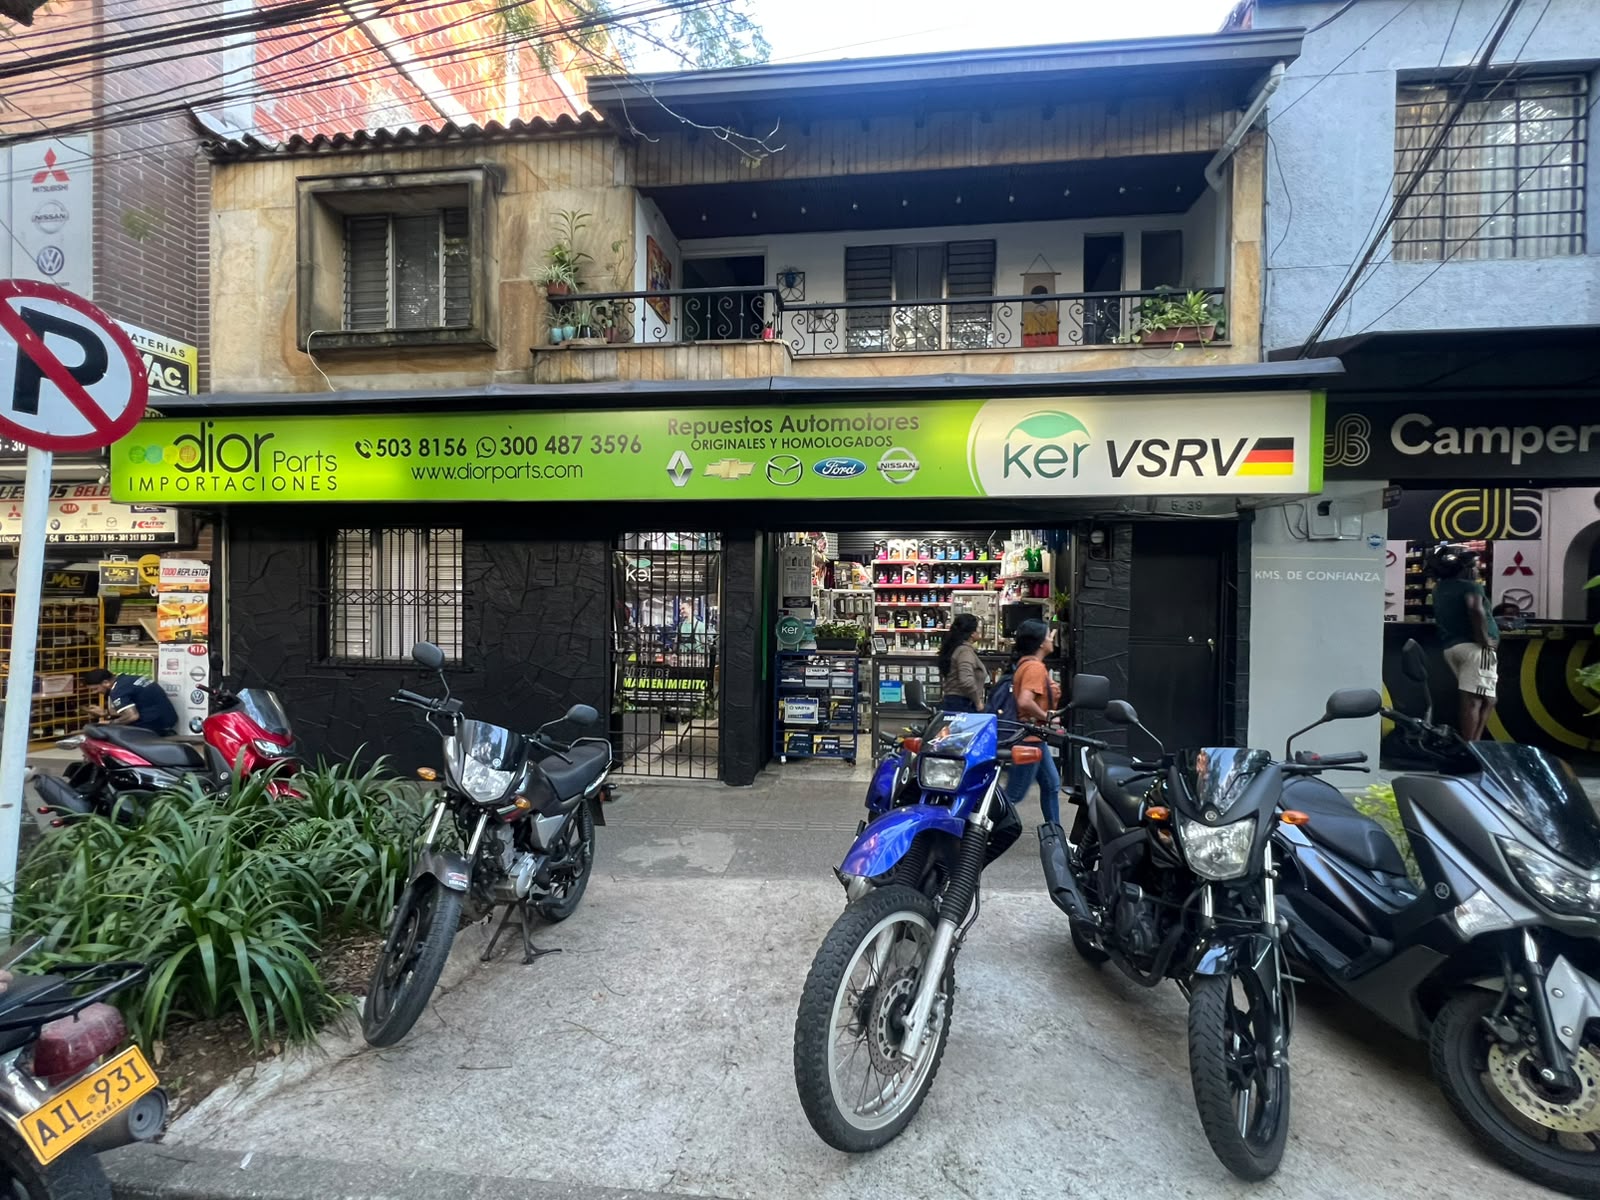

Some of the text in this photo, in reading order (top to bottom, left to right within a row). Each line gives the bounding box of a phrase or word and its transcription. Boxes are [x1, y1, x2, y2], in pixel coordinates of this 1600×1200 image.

[32, 185, 69, 193] MITSUBISHI
[33, 213, 67, 221] NISSAN
[126, 331, 186, 358] ATERÍAS
[12, 306, 108, 415] P
[668, 414, 920, 440] Repuestos Automotores
[173, 421, 338, 474] dior Parts
[375, 434, 643, 457] 503 8156 300 487 3596
[691, 435, 893, 451] ORIGINALES Y HOMOLOGADOS
[880, 462, 917, 470] NISSAN
[1003, 442, 1091, 479] ker
[1106, 438, 1249, 478] VSRV
[410, 462, 584, 484] www.diorparts.com
[821, 460, 857, 476] Ford
[73, 485, 111, 498] BELE
[129, 475, 338, 492] IMPORTACIONES
[62, 504, 77, 512] KIA
[1254, 571, 1381, 582] KMS. DE CONFIANZA
[190, 645, 206, 654] KIA
[36, 1099, 94, 1147] AIL
[80, 1098, 123, 1131] COLOMBIA
